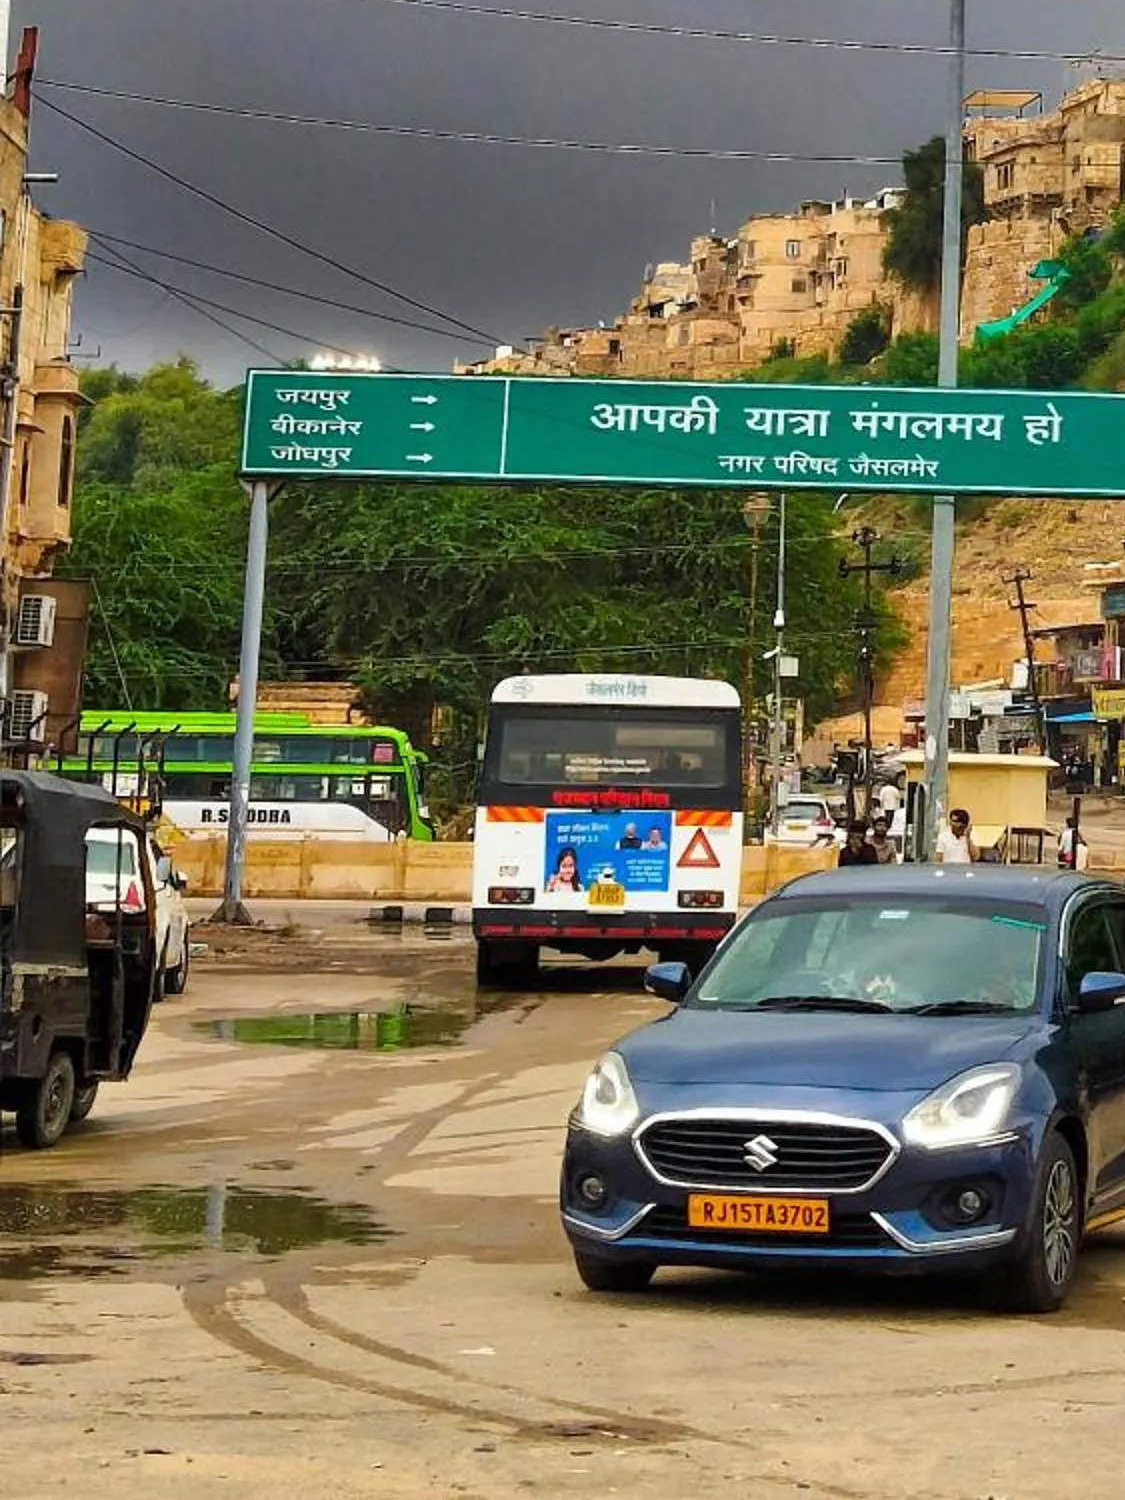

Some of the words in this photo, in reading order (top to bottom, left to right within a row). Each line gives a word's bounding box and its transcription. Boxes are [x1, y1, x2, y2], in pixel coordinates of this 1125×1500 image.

[274, 388, 351, 411] जयपुर
[590, 395, 720, 434] आपकी
[743, 407, 831, 437] यात्रा
[849, 401, 1004, 441] मंगलमय
[1022, 402, 1064, 445] हो
[717, 455, 765, 473] नगर
[773, 450, 840, 476] परिषद
[848, 452, 940, 477] जैसलमेर
[703, 1201, 825, 1227] RJ15TA3702
